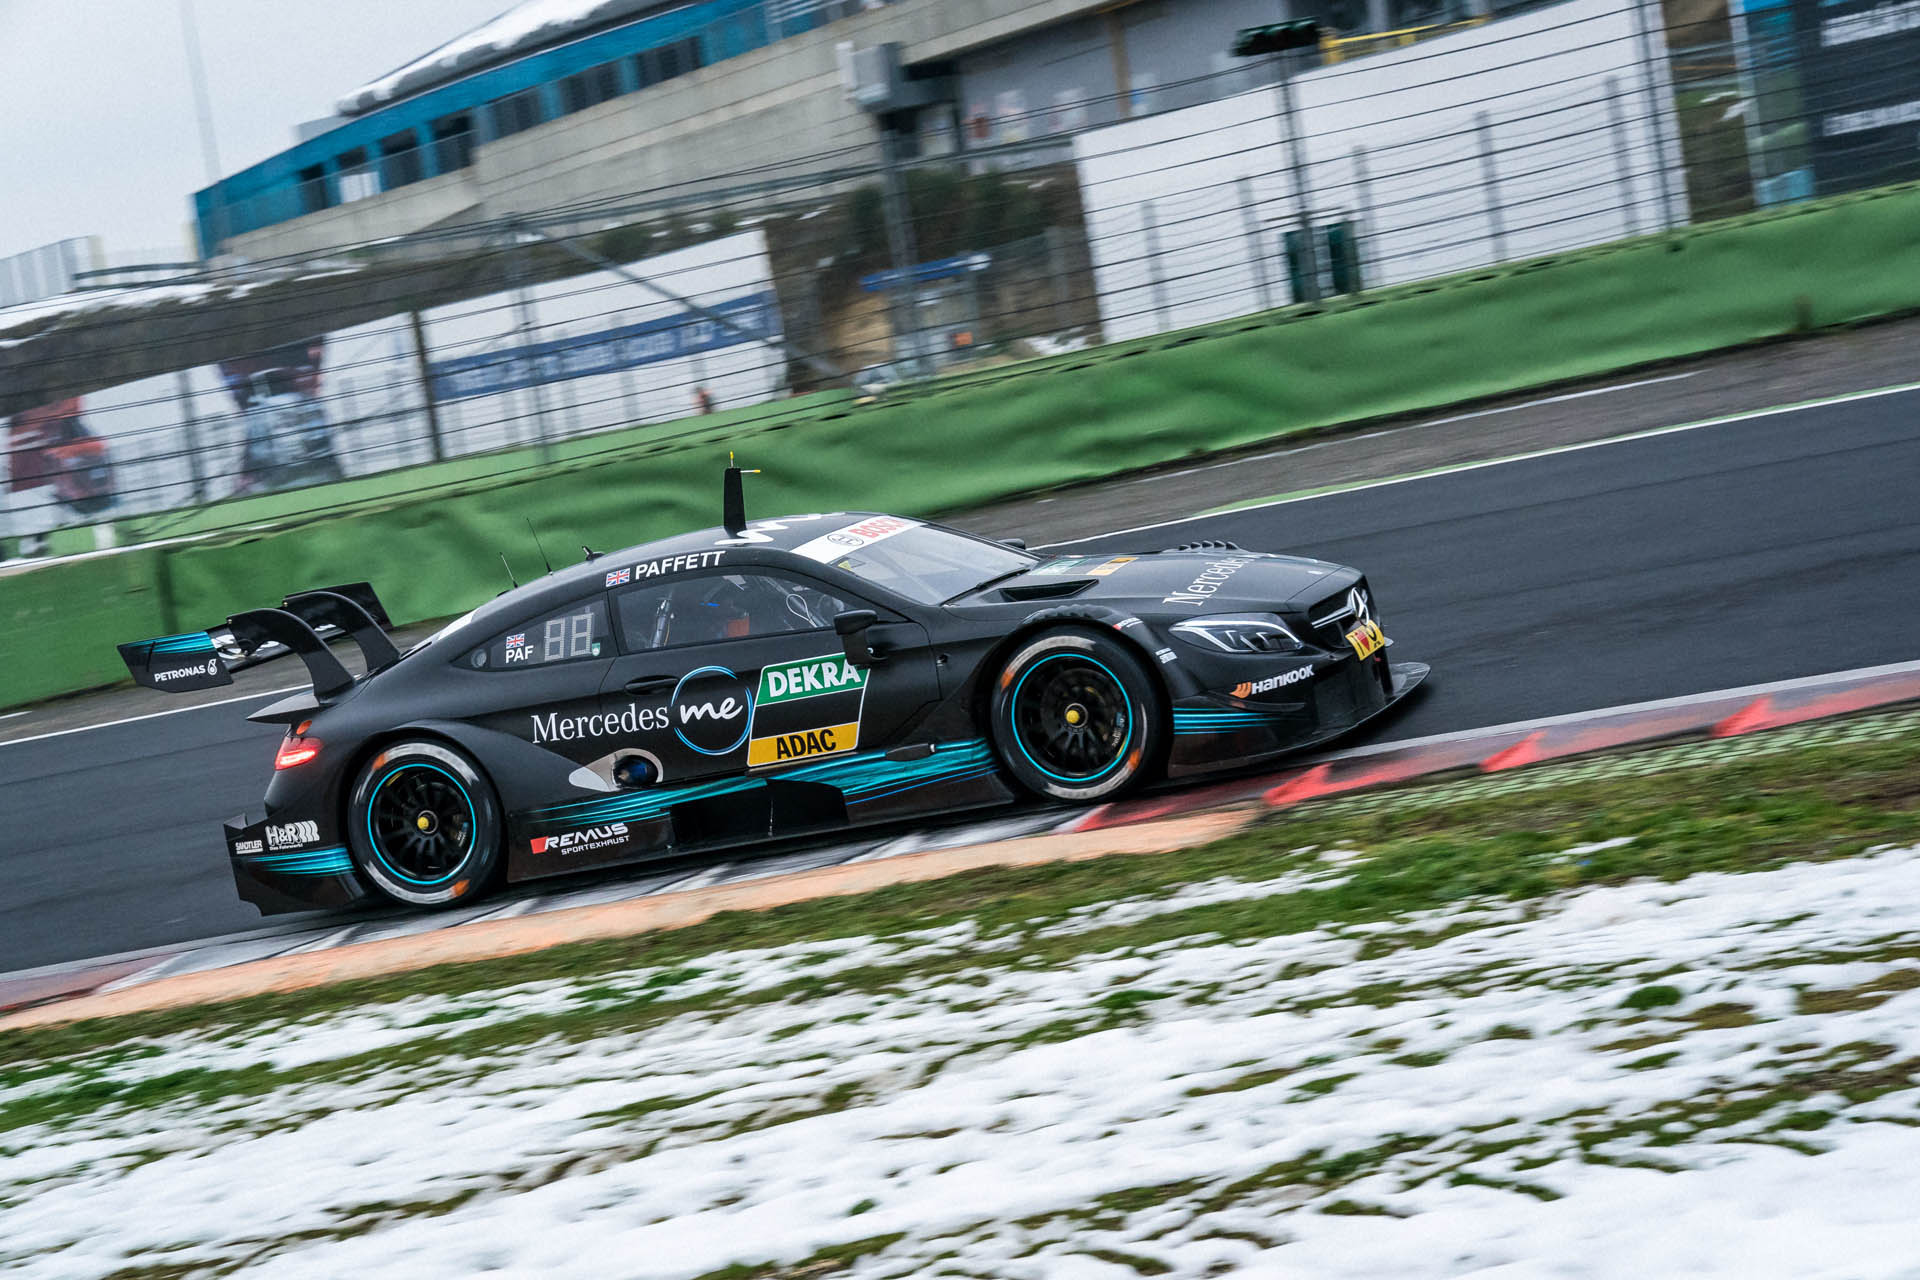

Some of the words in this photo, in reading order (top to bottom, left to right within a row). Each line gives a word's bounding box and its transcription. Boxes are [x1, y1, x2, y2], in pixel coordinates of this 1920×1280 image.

[847, 517, 906, 538] BOSC
[635, 550, 726, 580] PAFFETT
[505, 645, 534, 664] PAF
[154, 665, 206, 682] PETRONAS
[767, 659, 862, 697] DEKRA
[531, 703, 670, 744] Mercedes
[680, 697, 742, 724] me
[776, 729, 836, 760] ADAC
[544, 822, 629, 850] REMUS
[561, 835, 630, 855] SPORTEXHAUST
